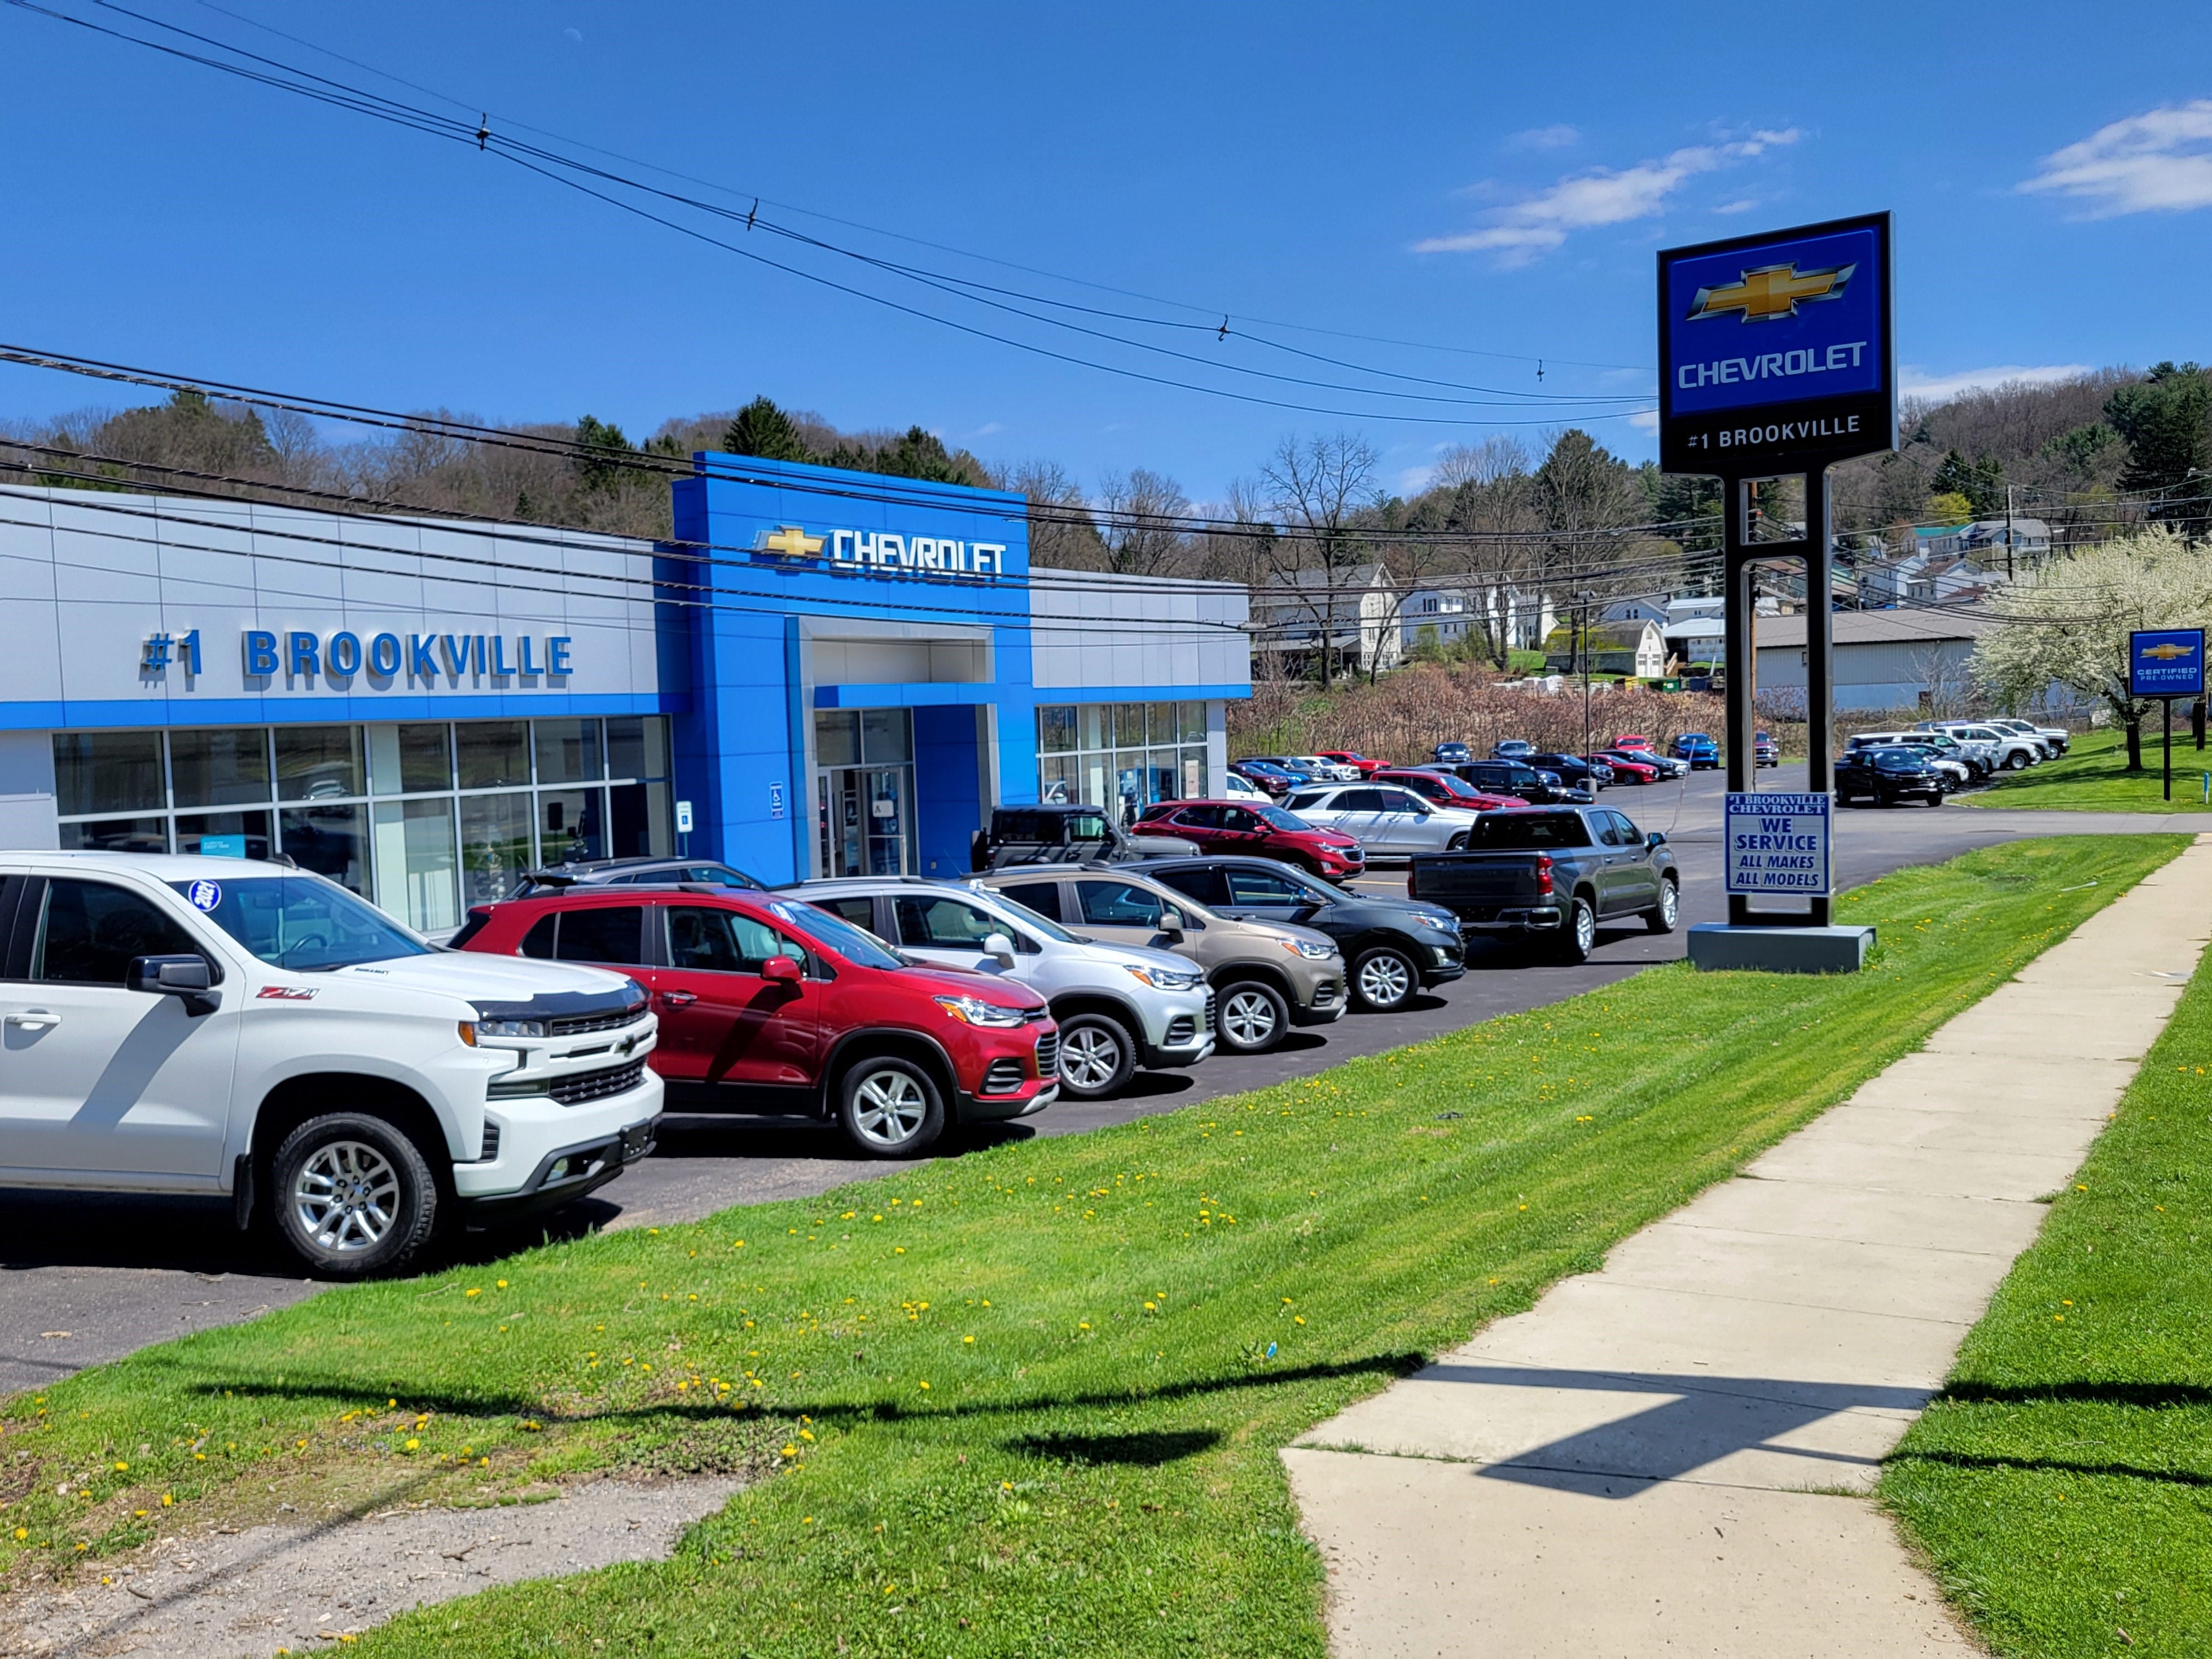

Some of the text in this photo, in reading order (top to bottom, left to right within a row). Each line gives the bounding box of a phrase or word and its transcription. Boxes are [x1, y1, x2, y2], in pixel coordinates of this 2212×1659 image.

[1679, 341, 1867, 389] CHEVROLET
[1688, 415, 1860, 449] #1 BROOKVILLE
[832, 529, 1006, 579] CHEVROLET
[145, 629, 573, 676] #1 BROOKVILLE
[1729, 795, 1825, 805] #1 BROOKVILLE
[1729, 805, 1825, 814] CHEVROLET
[1760, 818, 1792, 833] WE
[1735, 835, 1817, 851] SERVICE
[1739, 855, 1814, 868] ALL MAKES
[1735, 872, 1819, 887] ALL MODELS
[194, 880, 216, 909] 2021
